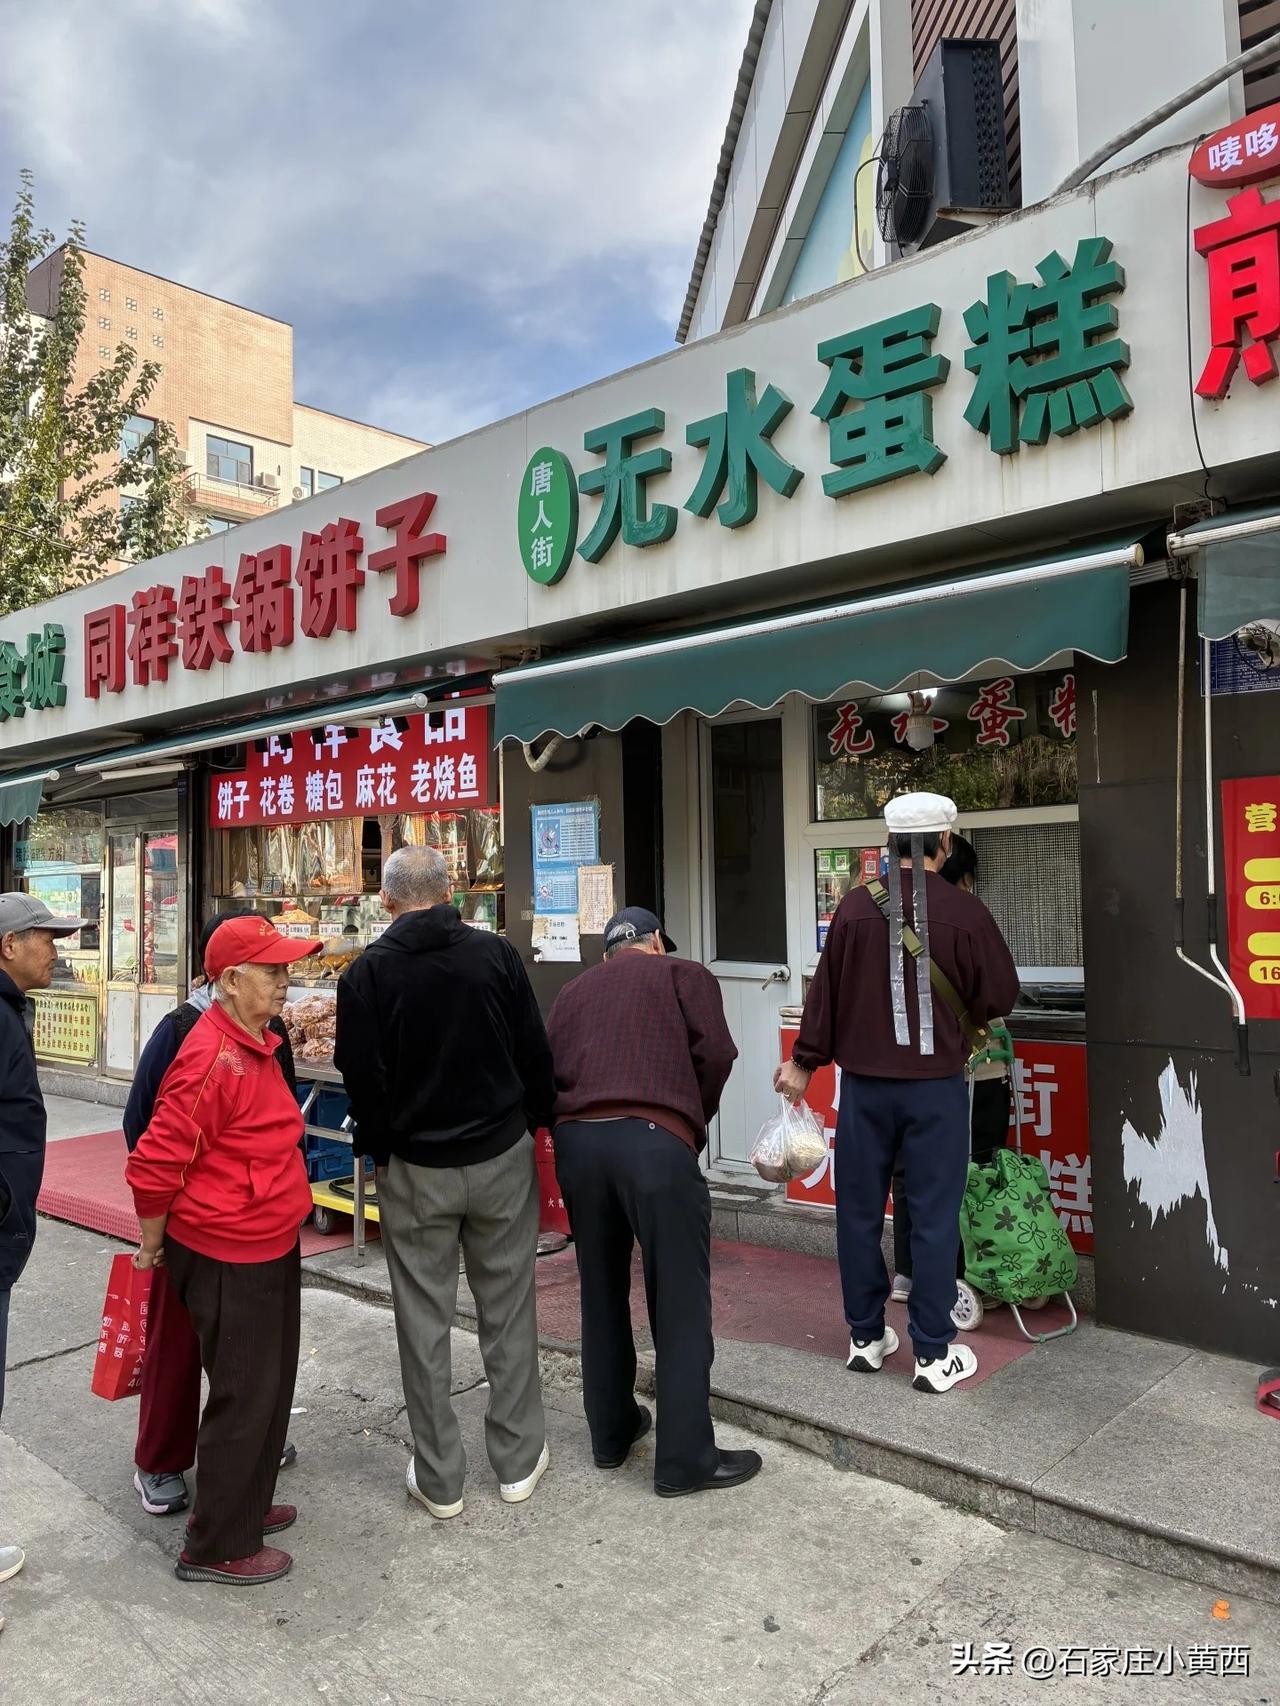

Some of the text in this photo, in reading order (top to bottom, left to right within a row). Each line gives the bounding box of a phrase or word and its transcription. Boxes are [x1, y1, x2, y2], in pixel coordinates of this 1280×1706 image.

[576, 237, 1134, 564] 无水蛋糕
[530, 461, 553, 571] 唐人街
[84, 492, 447, 699] 同祥铁锅饼子
[217, 752, 479, 820] 饼子 花卷 糖包 麻花 老烧鱼
